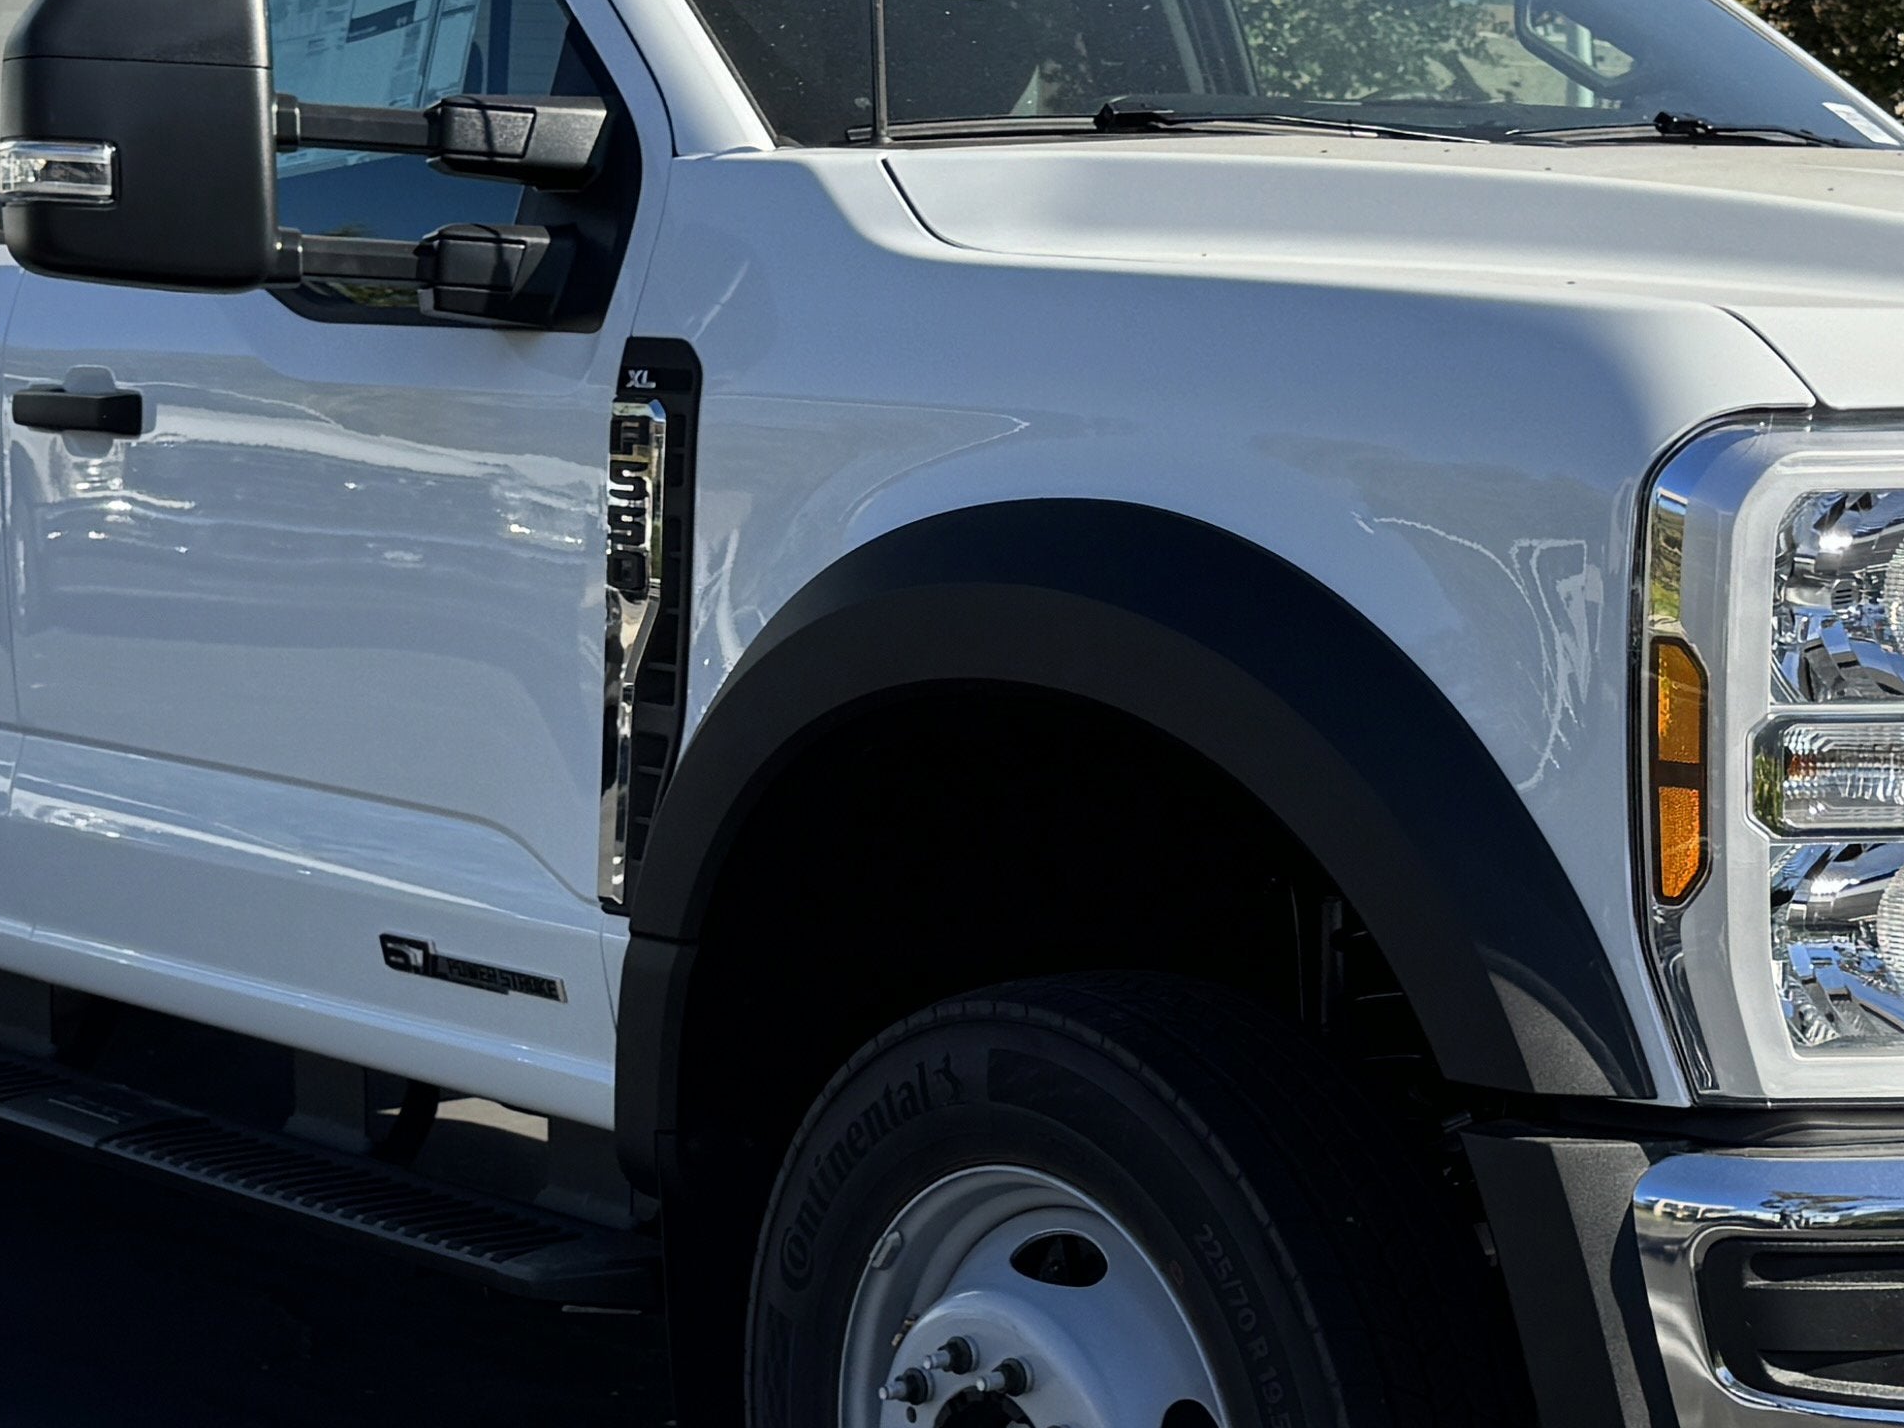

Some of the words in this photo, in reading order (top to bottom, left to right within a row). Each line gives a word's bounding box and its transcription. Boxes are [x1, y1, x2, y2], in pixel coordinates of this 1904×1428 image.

[625, 369, 657, 389] XL
[780, 1060, 935, 1293] Continental
[1194, 1222, 1257, 1333] 225/70
[1247, 1335, 1270, 1361] R
